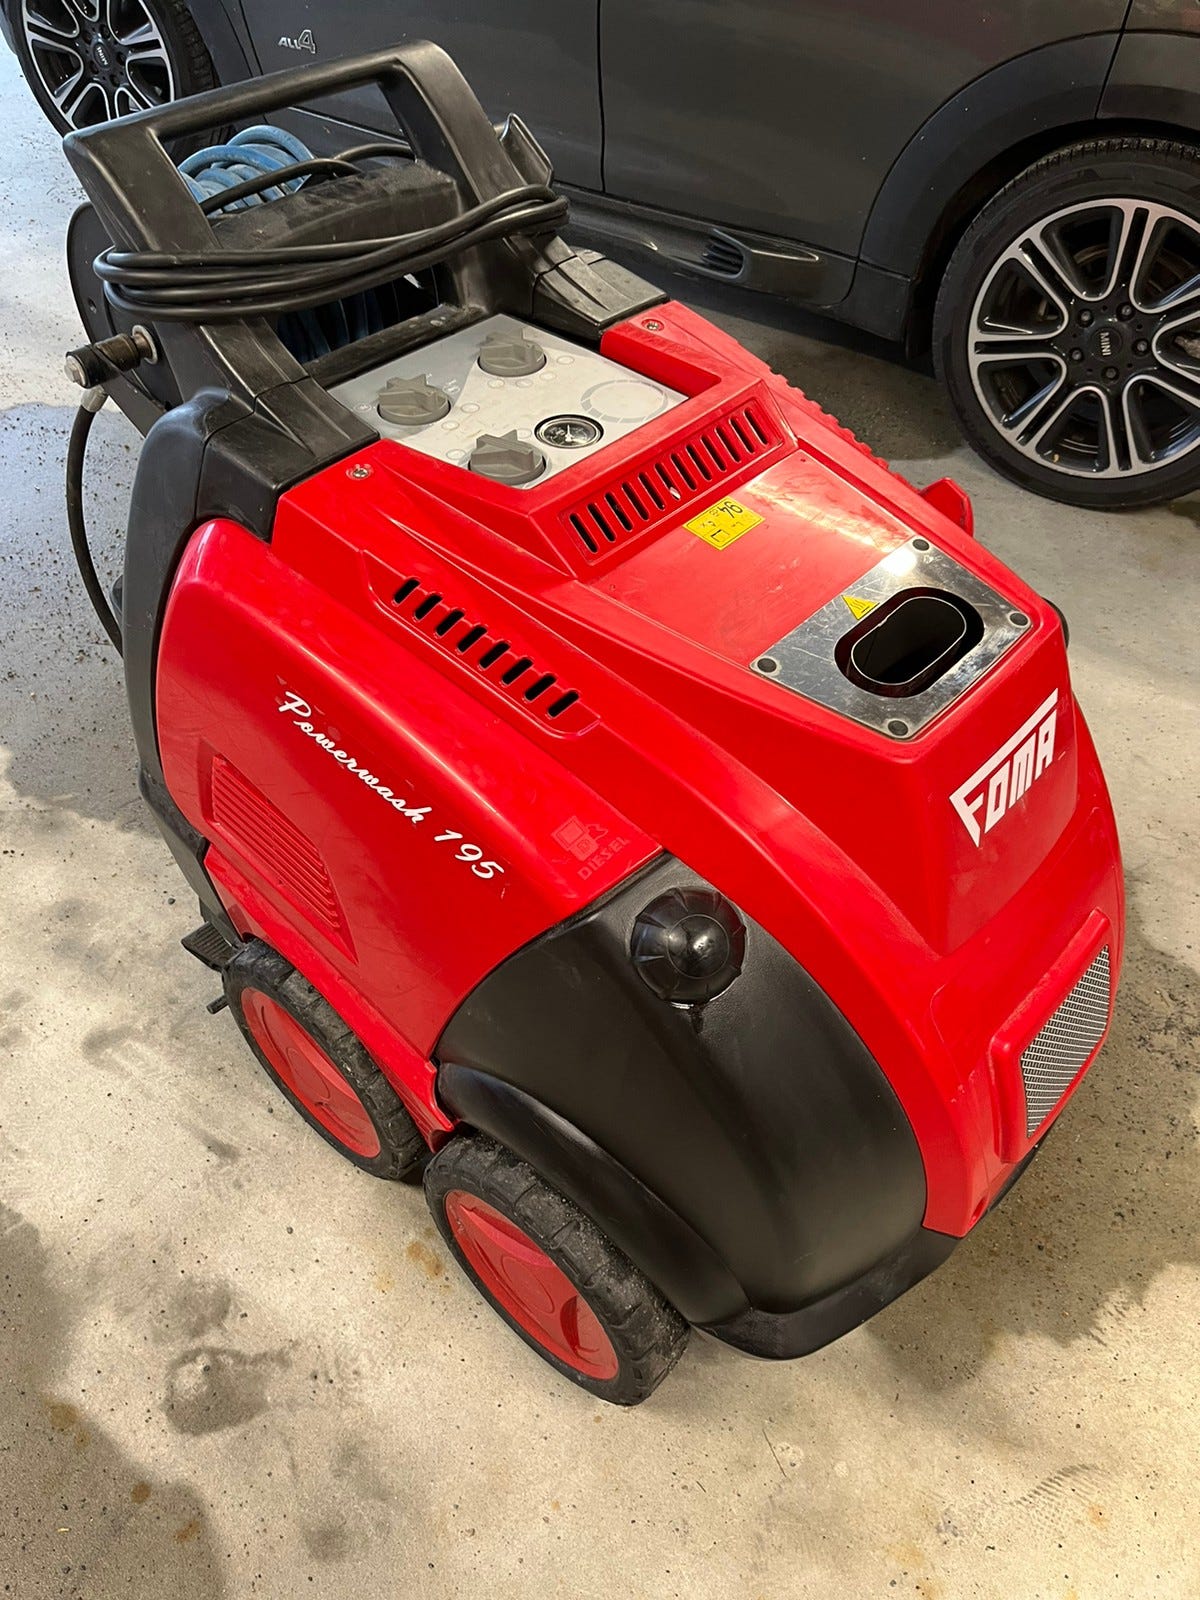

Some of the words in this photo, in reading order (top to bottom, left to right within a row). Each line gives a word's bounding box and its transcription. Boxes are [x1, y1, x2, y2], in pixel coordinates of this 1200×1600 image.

[1100, 331, 1112, 356] MINI
[278, 691, 432, 824] Powerwash
[434, 829, 505, 879] 195
[949, 687, 1059, 848] FOMA
[577, 836, 631, 880] DIESEL
